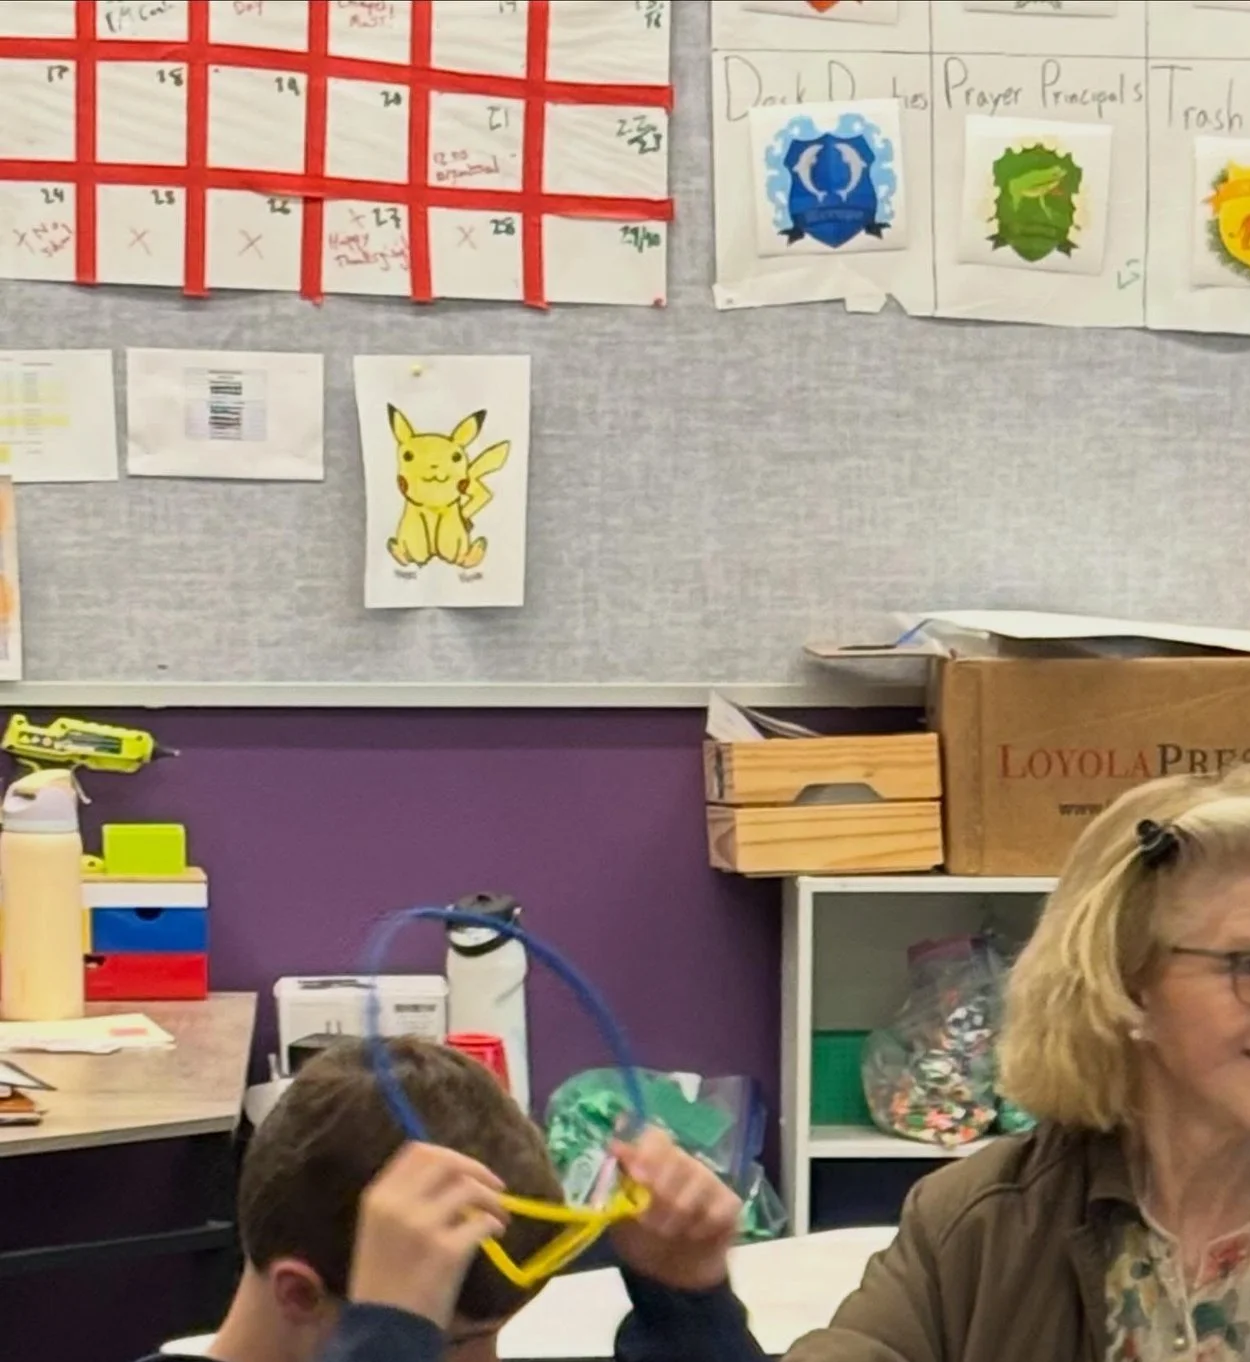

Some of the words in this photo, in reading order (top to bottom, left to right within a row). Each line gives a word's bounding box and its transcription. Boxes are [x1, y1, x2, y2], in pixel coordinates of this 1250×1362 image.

[944, 56, 1023, 117] Prayer
[1041, 59, 1143, 119] Principals
[1151, 64, 1243, 132] Trash
[41, 187, 65, 204] 24
[372, 207, 401, 228] 27
[490, 216, 515, 235] 28
